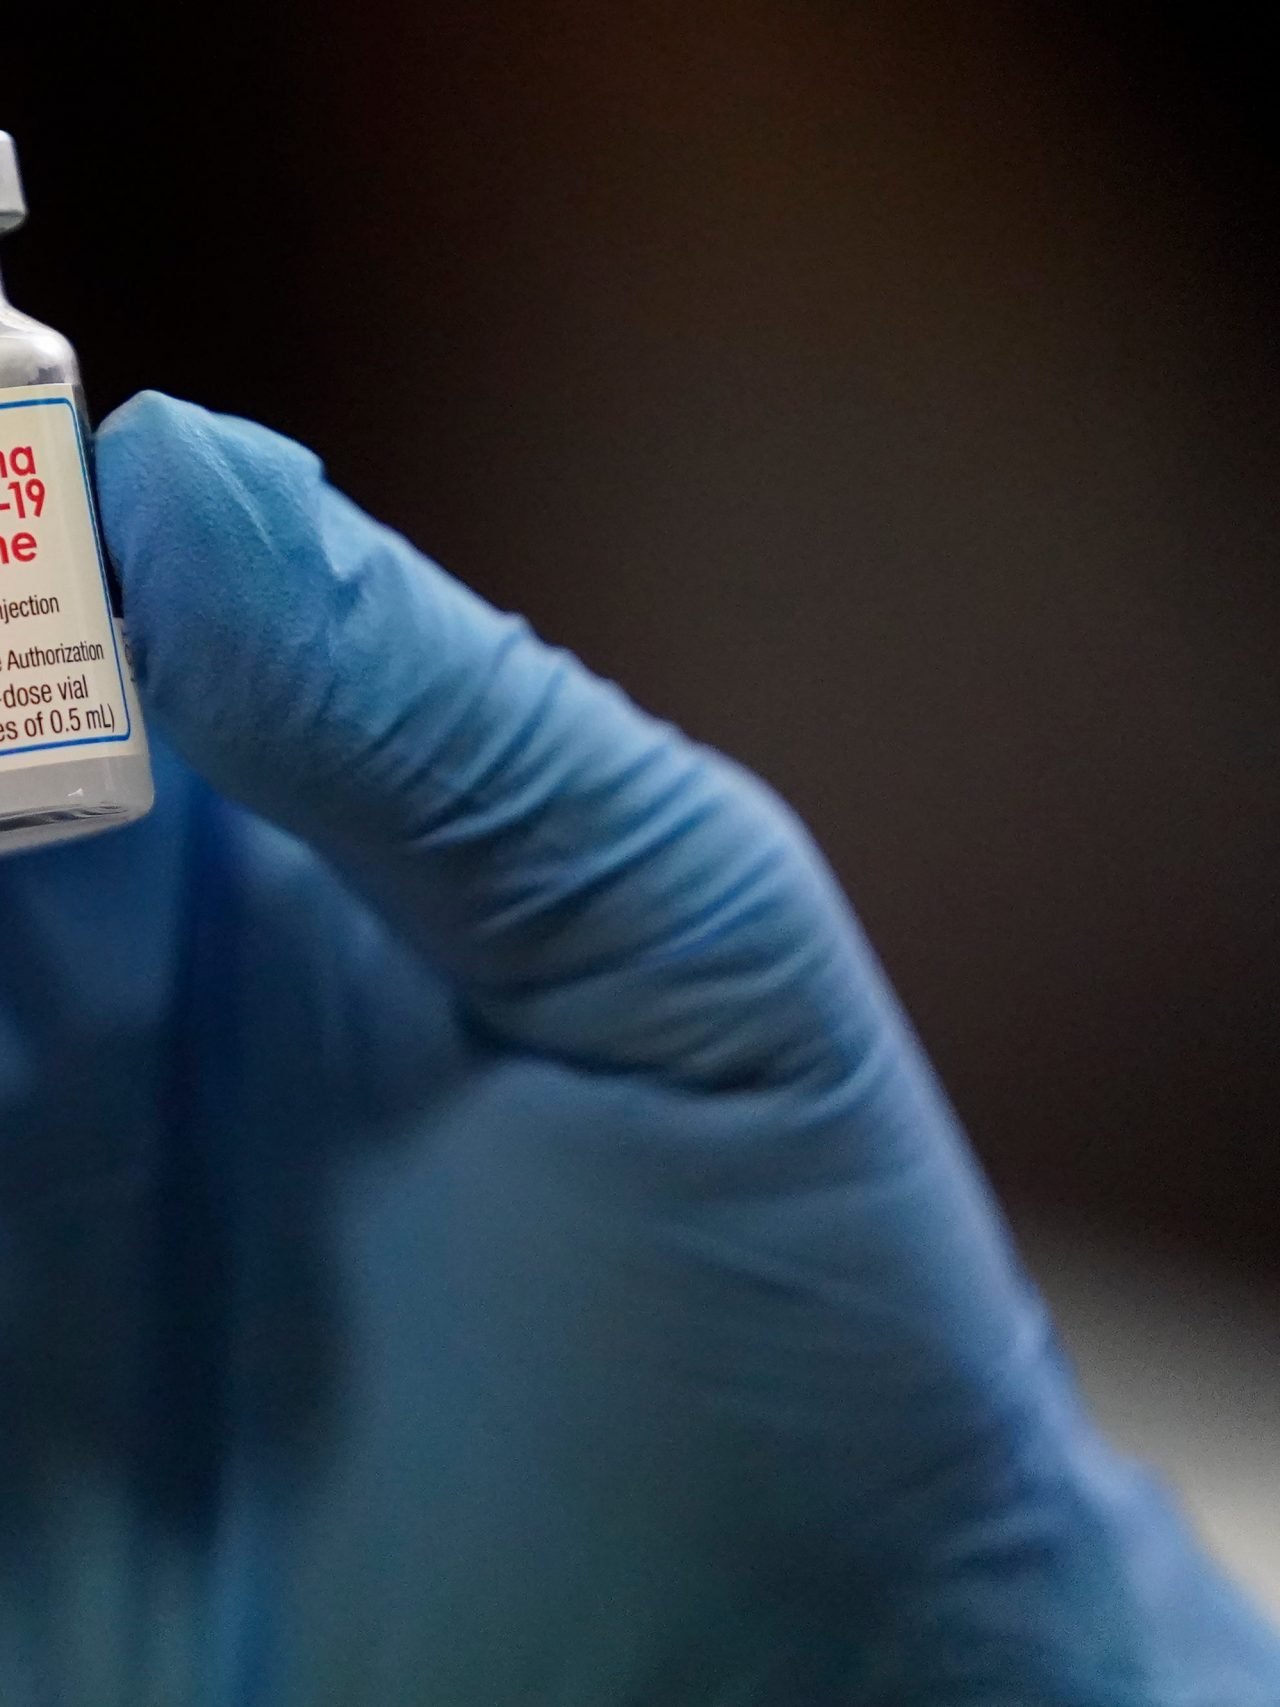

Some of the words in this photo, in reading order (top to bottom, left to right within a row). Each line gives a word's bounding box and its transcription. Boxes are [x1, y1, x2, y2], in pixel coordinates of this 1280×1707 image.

[7, 641, 104, 671] Authorization
[57, 675, 89, 699] vial
[24, 712, 45, 739] of
[50, 706, 81, 734] 0.5
[90, 703, 115, 733] mL)
